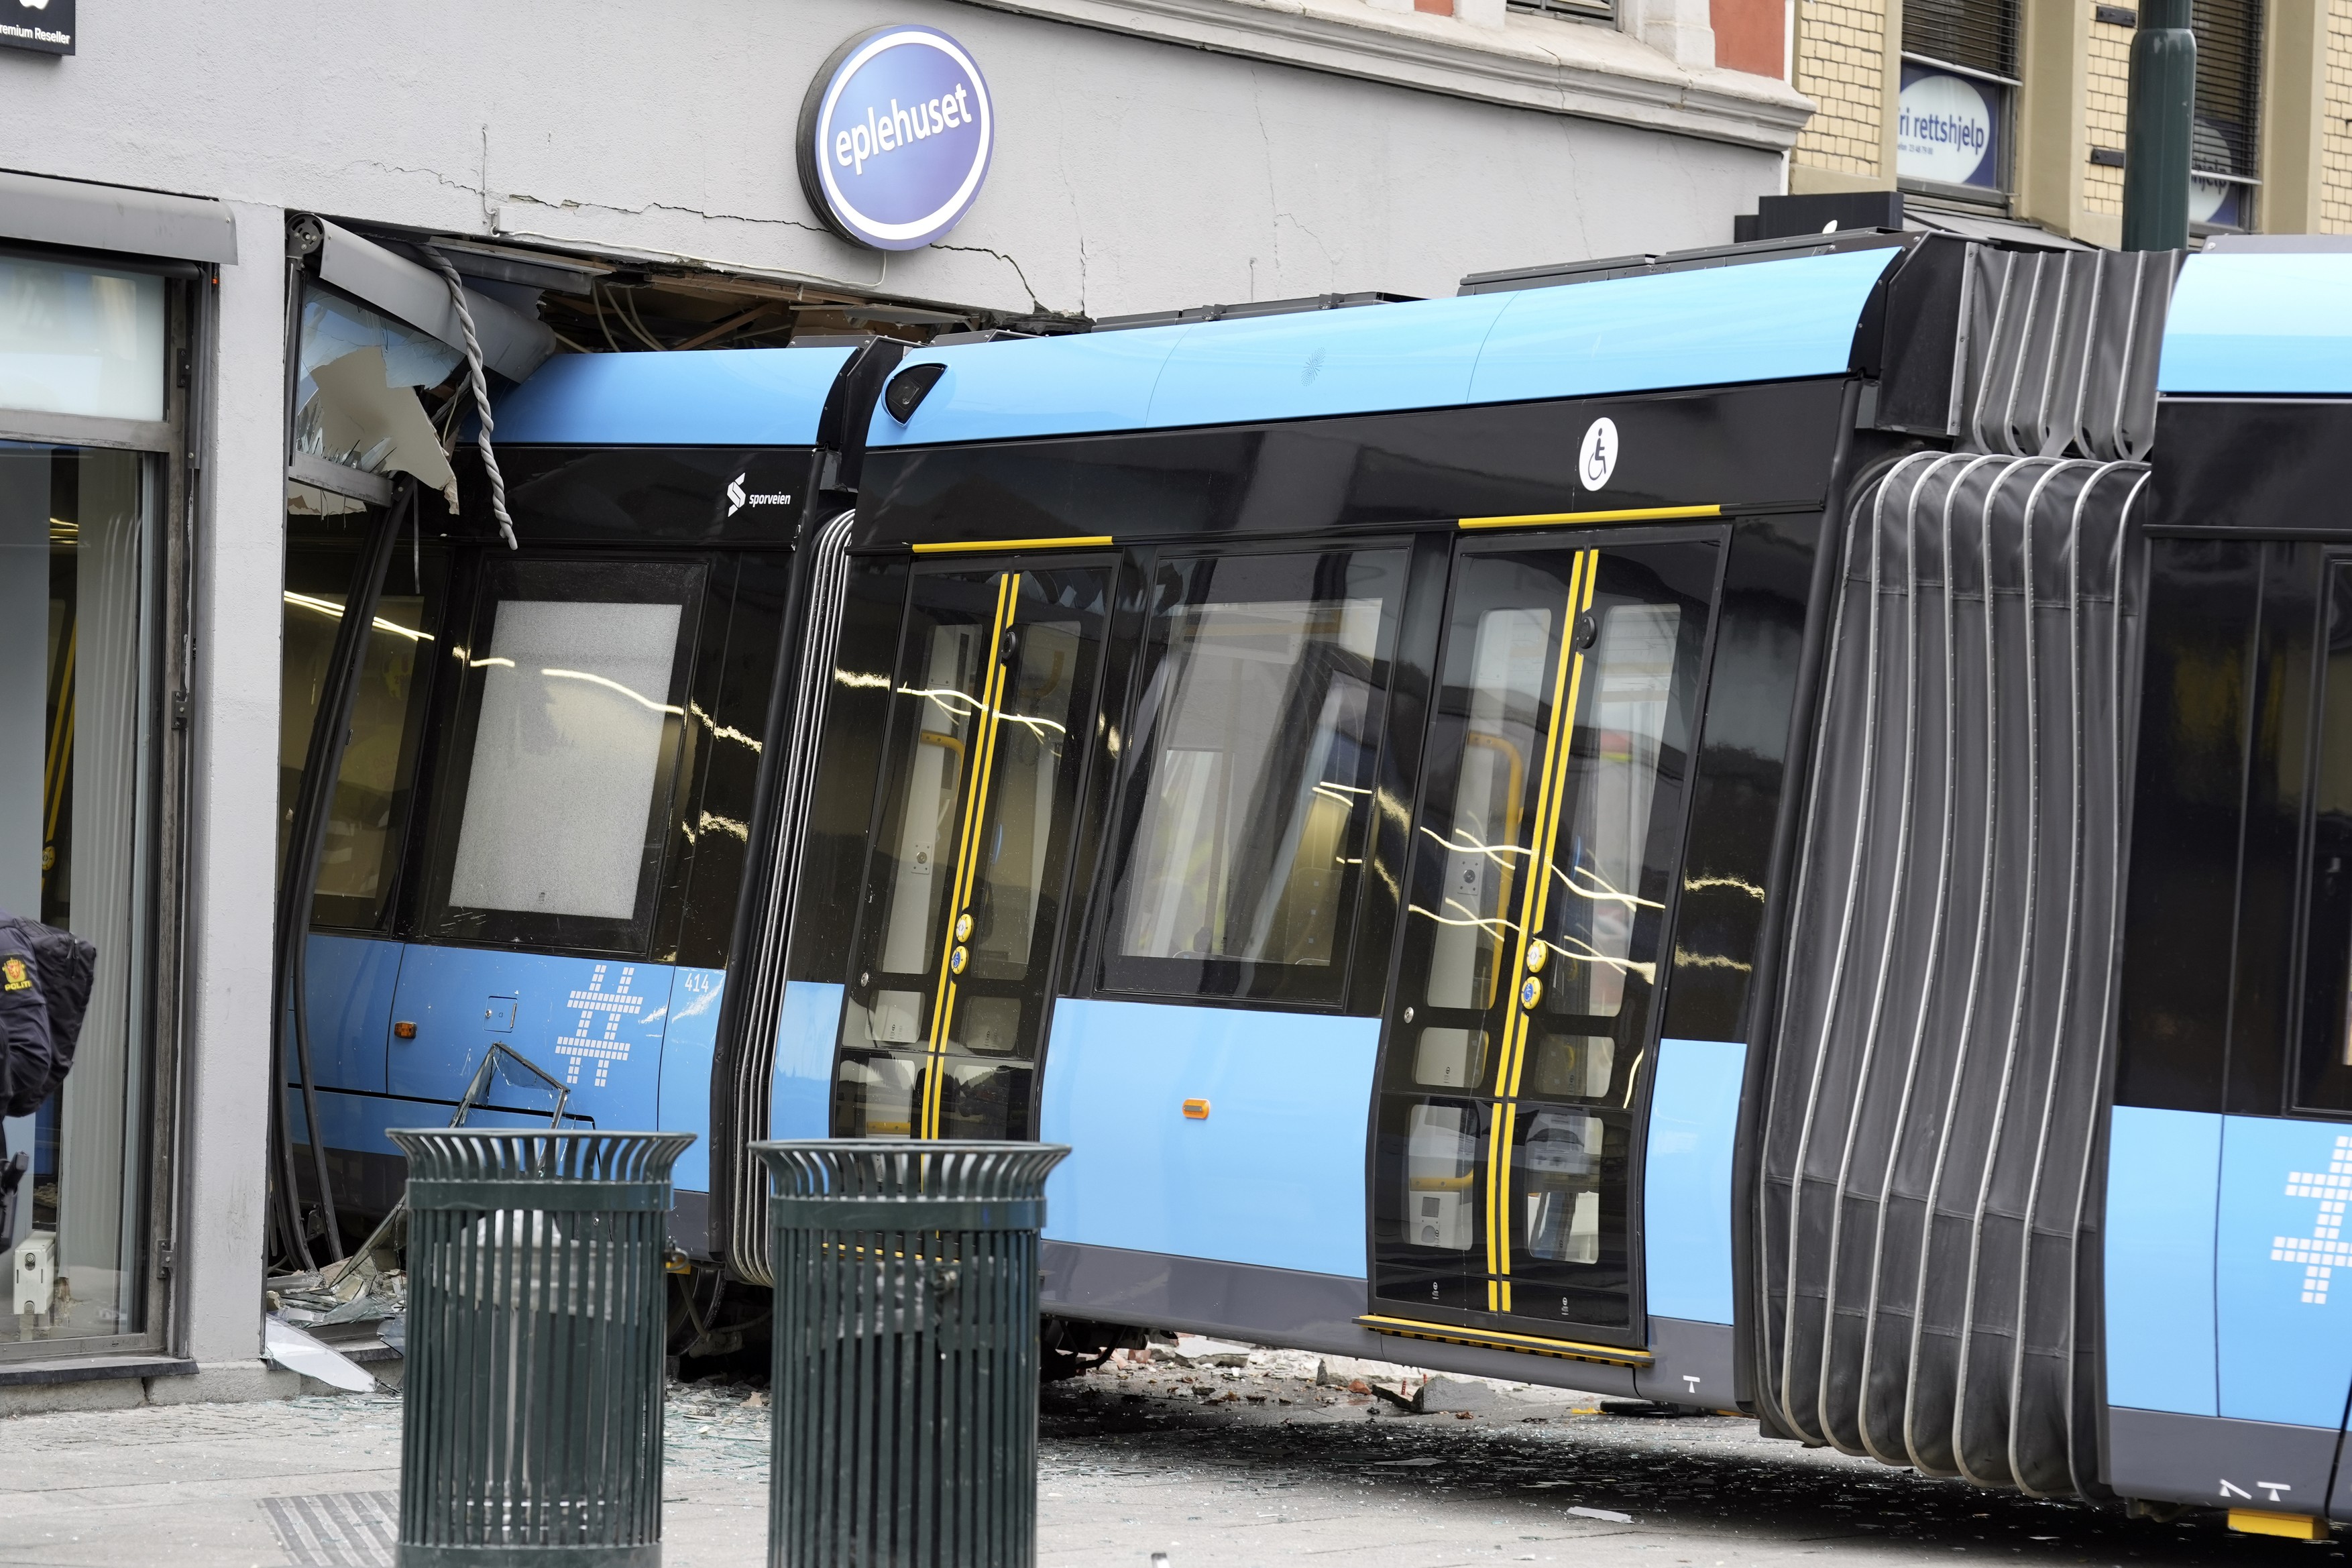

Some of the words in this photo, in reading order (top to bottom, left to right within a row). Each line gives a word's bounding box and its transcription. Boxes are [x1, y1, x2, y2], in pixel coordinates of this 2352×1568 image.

[0, 24, 34, 39] remium
[34, 27, 71, 45] Reseller
[836, 82, 972, 175] eplehuset
[1898, 107, 1910, 136] ri
[1914, 113, 1984, 156] rettshjelp
[748, 491, 791, 508] sporveien
[4, 980, 32, 991] POLITI
[684, 972, 710, 993] 414
